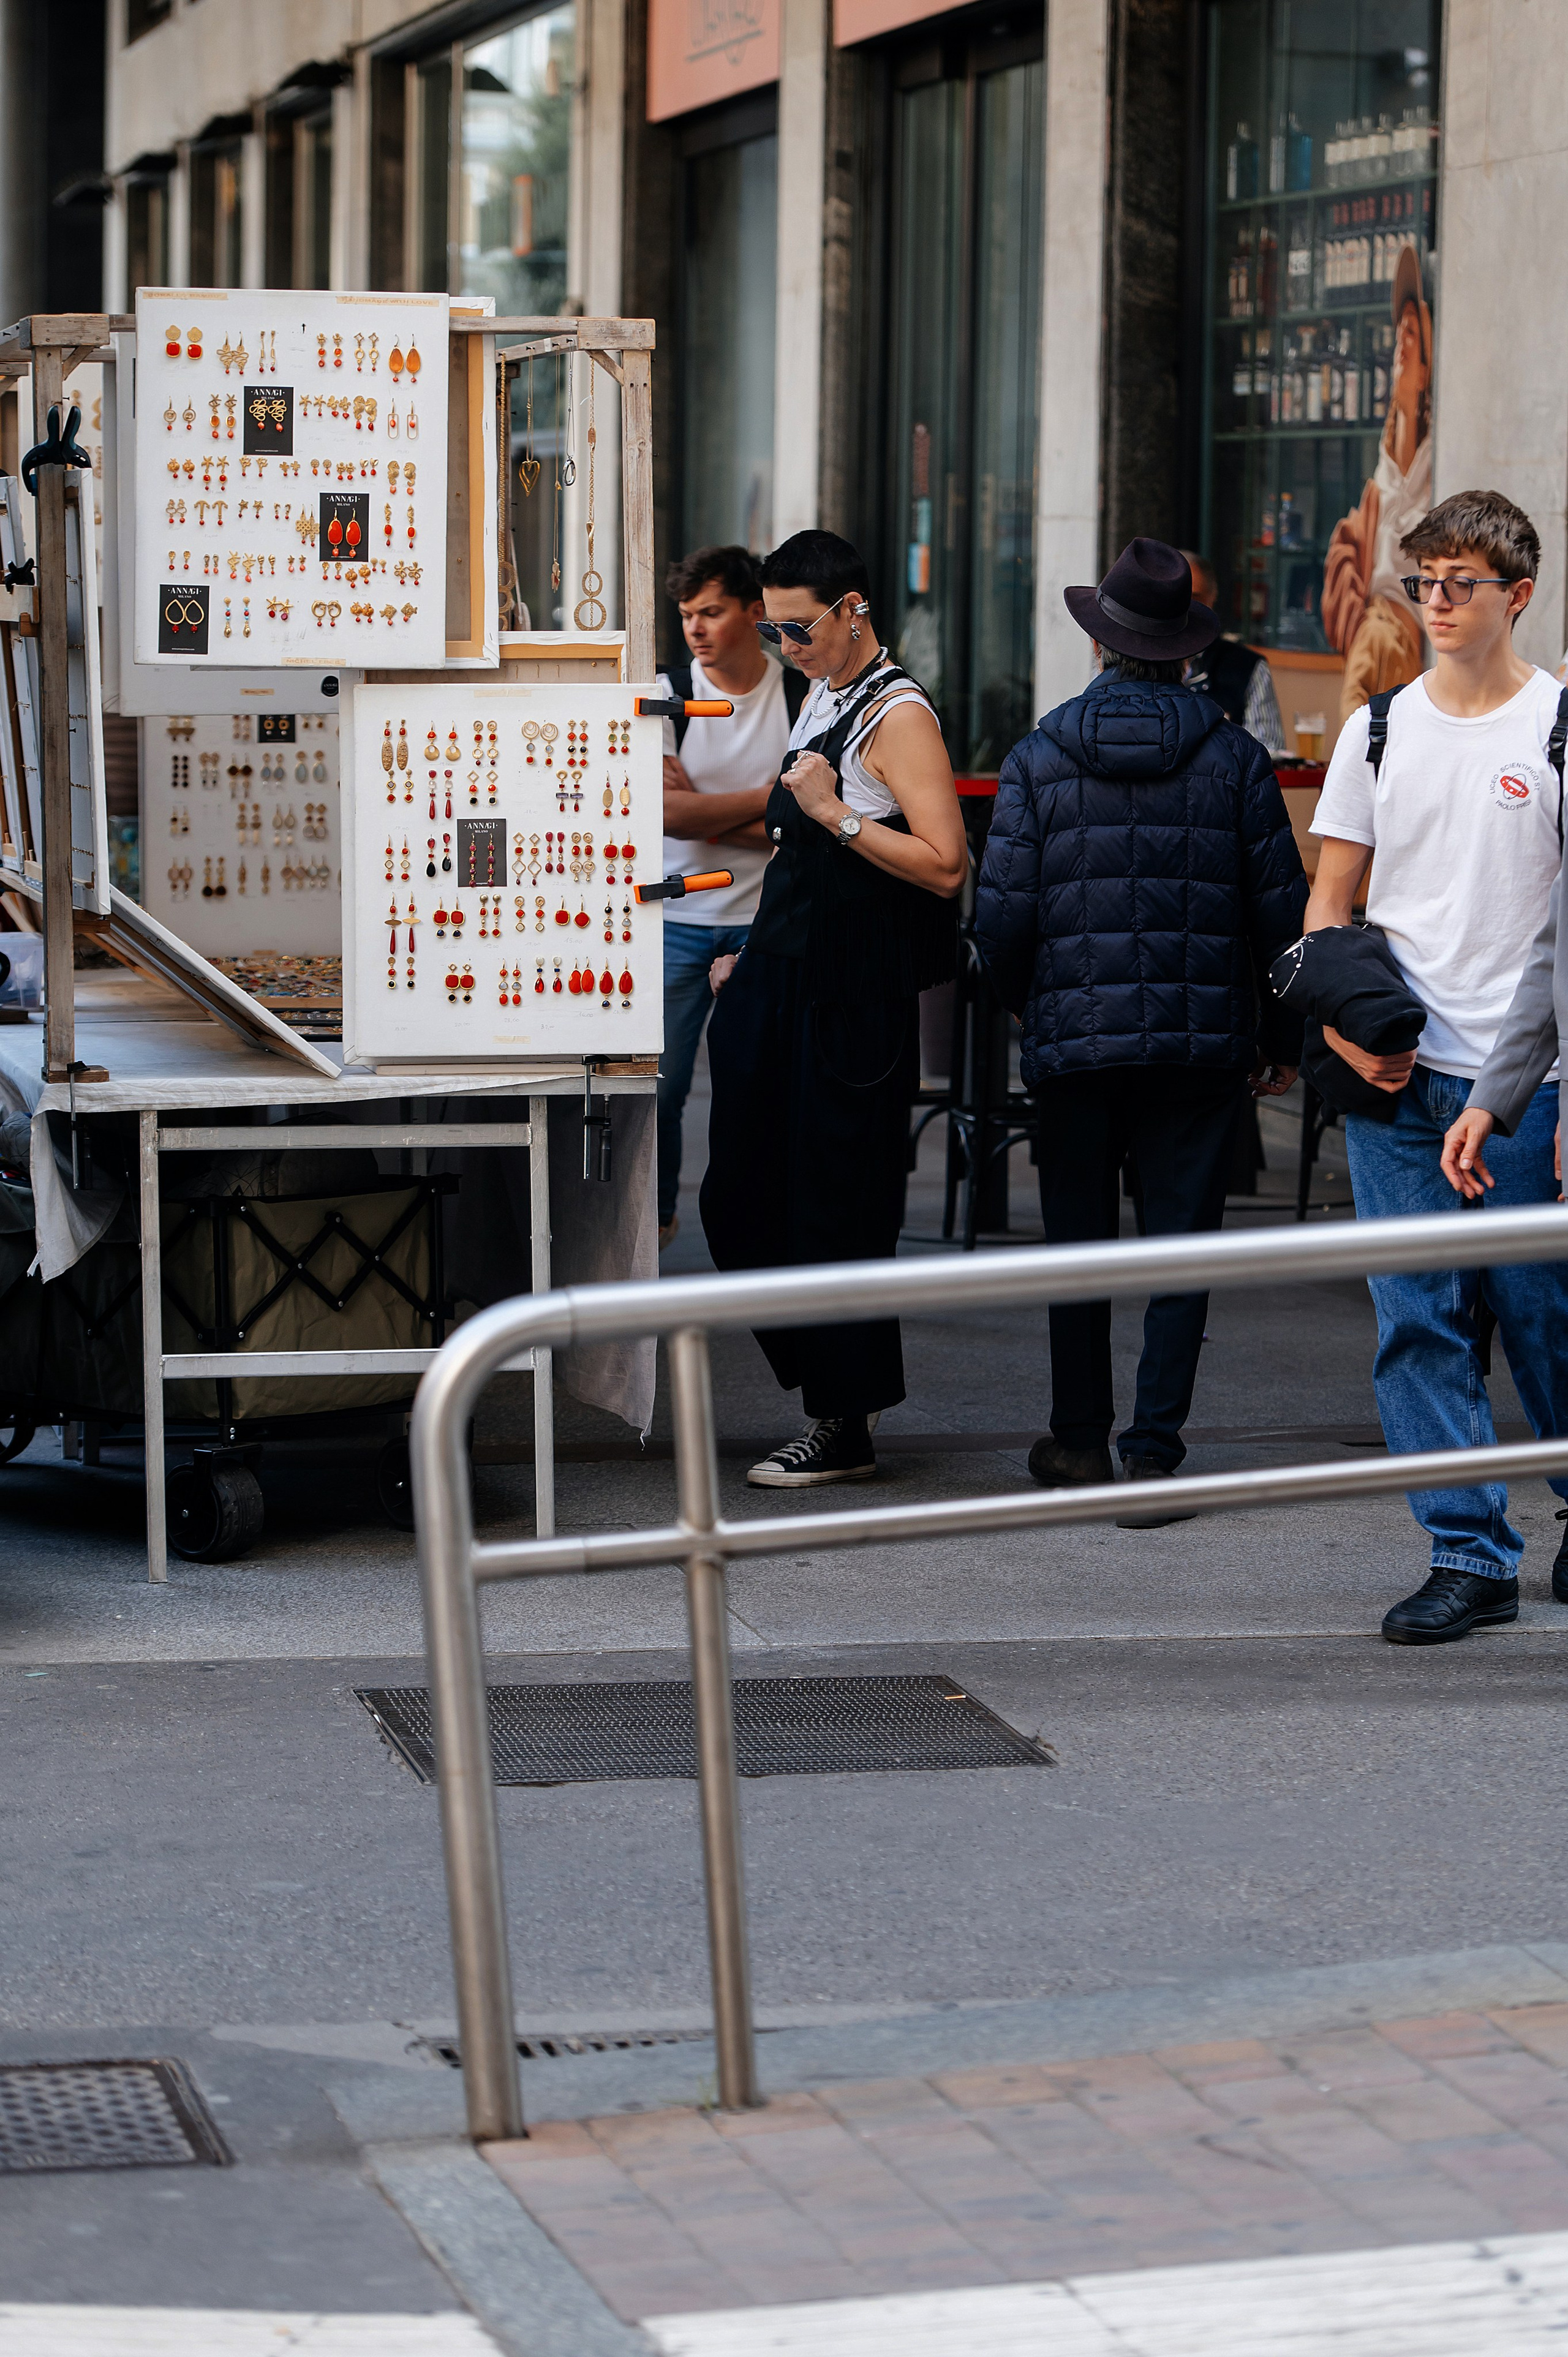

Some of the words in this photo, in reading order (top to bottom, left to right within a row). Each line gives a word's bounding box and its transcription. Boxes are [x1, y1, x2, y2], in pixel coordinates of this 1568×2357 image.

[1490, 774, 1499, 794] LICEO
[1500, 763, 1539, 781] SCIENTIFICO
[1496, 799, 1516, 810] PAOLO
[1516, 799, 1532, 809] FRISI
